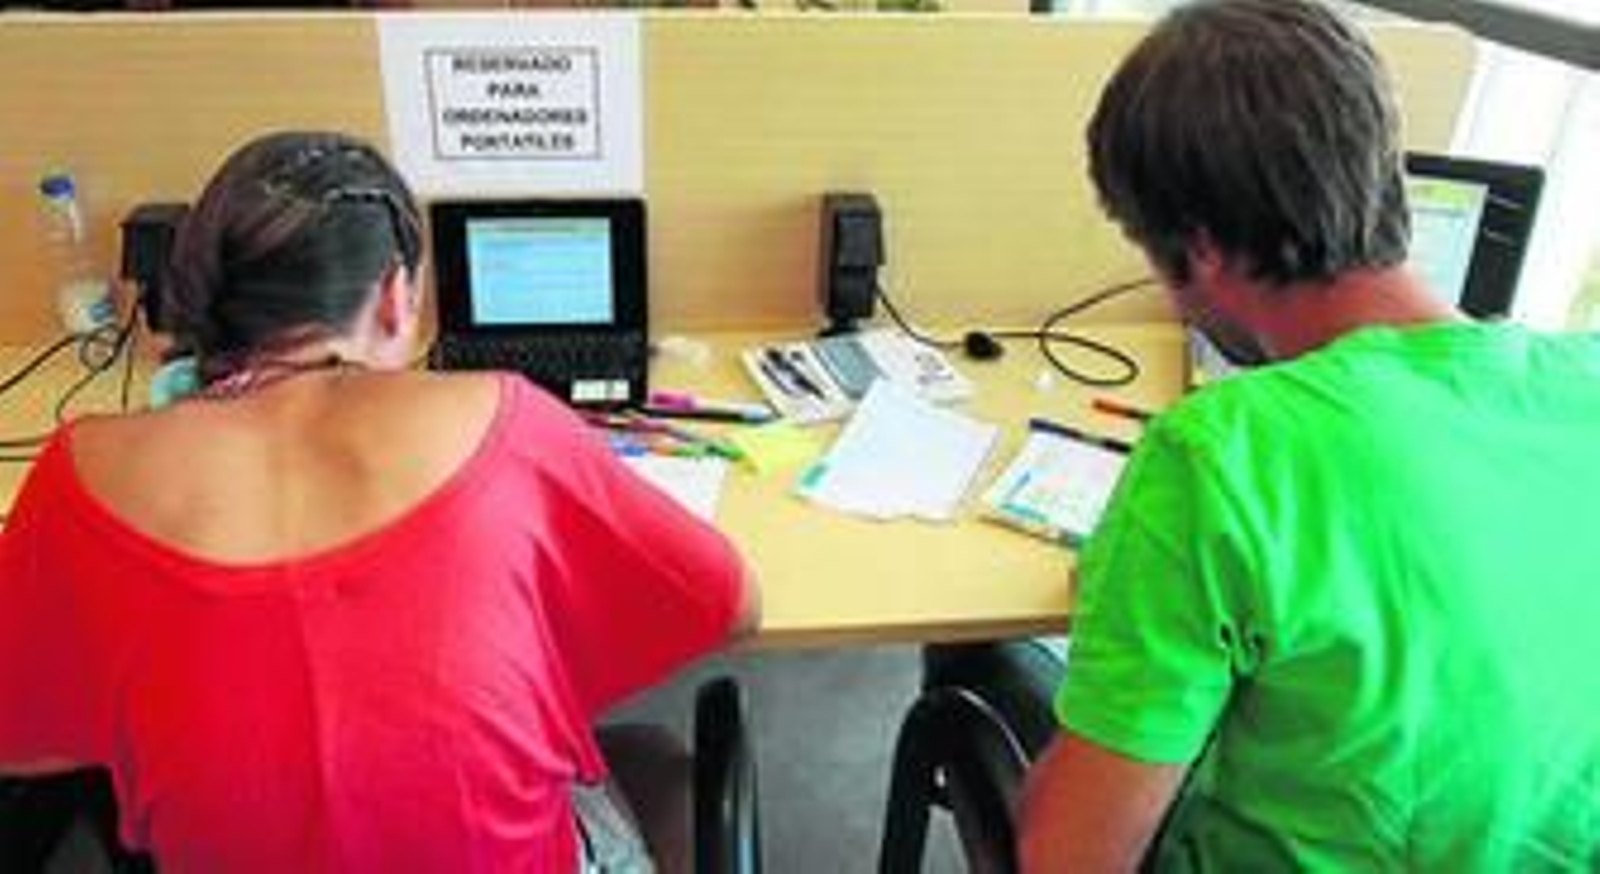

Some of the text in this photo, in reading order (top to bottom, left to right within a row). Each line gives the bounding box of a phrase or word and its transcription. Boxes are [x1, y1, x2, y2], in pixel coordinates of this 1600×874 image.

[452, 54, 572, 73] RESERVADO
[486, 81, 540, 99] PARA
[442, 108, 587, 125] ORDENADORES
